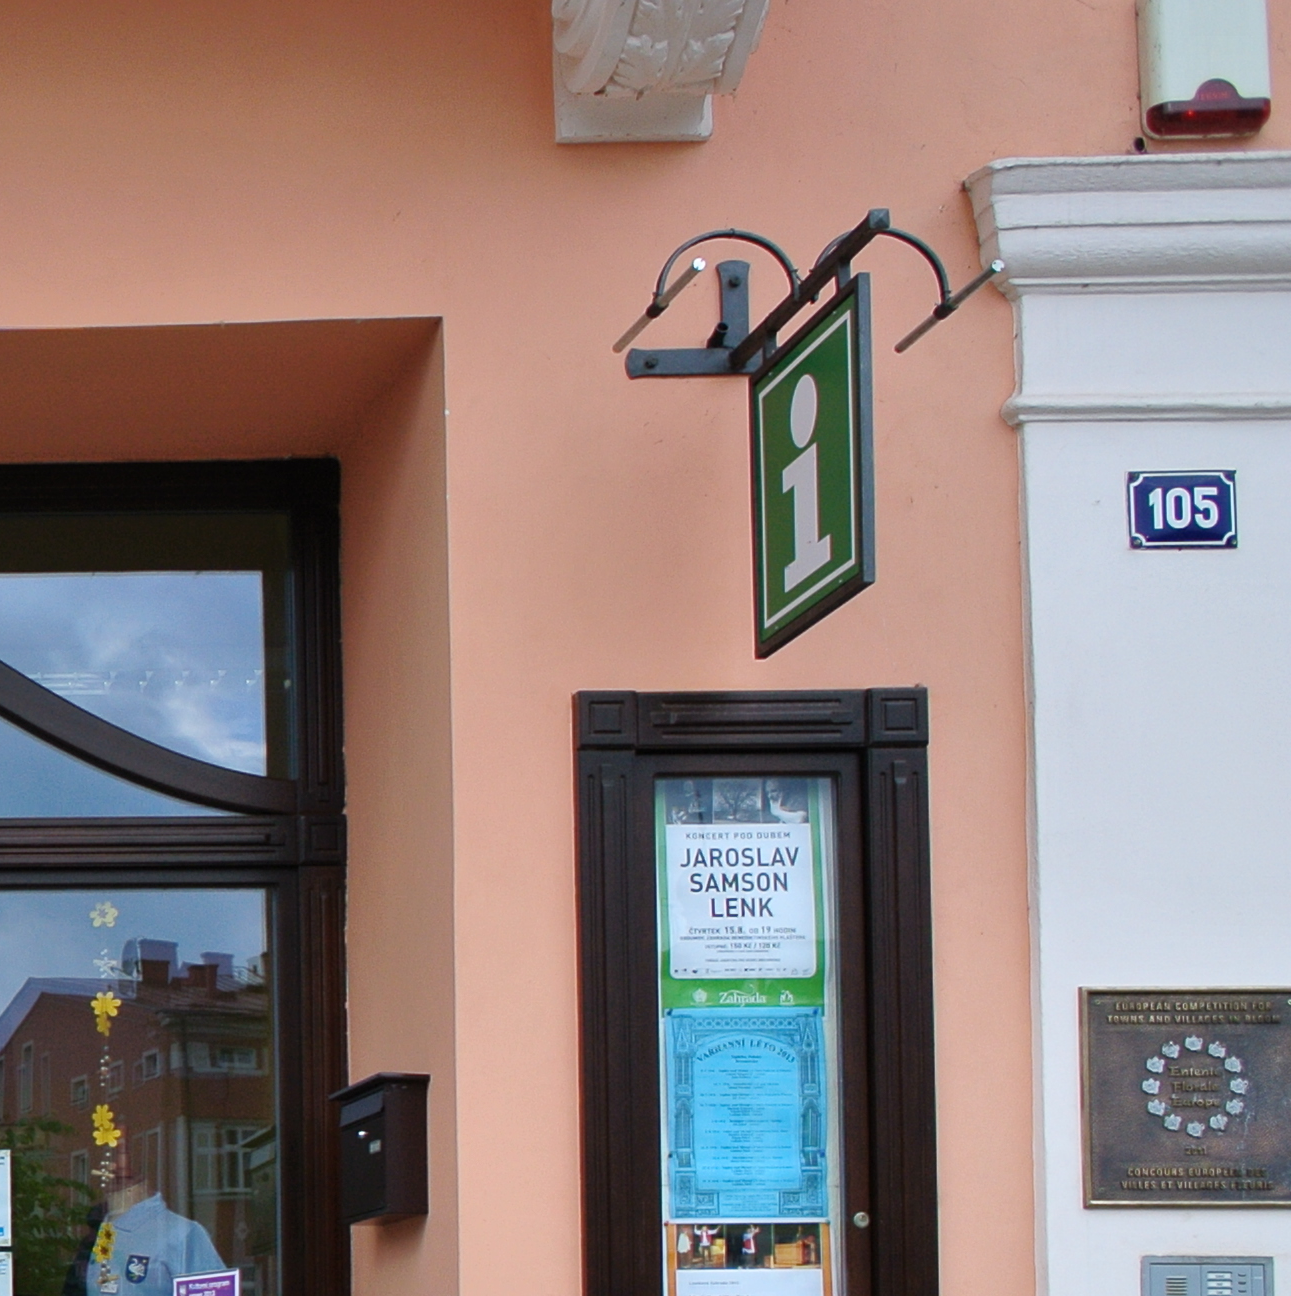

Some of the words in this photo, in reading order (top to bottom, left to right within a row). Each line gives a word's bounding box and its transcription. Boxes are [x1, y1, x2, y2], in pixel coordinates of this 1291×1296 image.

[1148, 486, 1220, 529] 105
[685, 832, 730, 840] KONCERT
[734, 832, 753, 840] POD
[756, 831, 791, 839] DUBEM
[680, 846, 799, 868] JAROSLAV
[689, 872, 789, 893] SAMSON
[710, 897, 774, 918] LENK
[688, 926, 720, 935] ČTVRTEK
[724, 926, 746, 935] 15.8.
[761, 926, 771, 934] 19
[718, 990, 767, 1007] Zahrada
[1115, 1001, 1172, 1012] EUROPEAN
[1174, 1001, 1248, 1012] COMPETITION
[1252, 1001, 1272, 1012] FOR
[1106, 1014, 1145, 1024] TOWNS
[1149, 1014, 1171, 1024] AND
[1174, 1015, 1225, 1025] VILLAGES
[696, 1037, 746, 1062] VARHANNÍ
[749, 1038, 776, 1052] LÉTO
[777, 1048, 796, 1063] 2013
[1127, 1167, 1185, 1178] CONCOURS
[1121, 1180, 1157, 1191] VILLES
[1160, 1180, 1173, 1191] ET
[1176, 1180, 1227, 1191] VILLAGES
